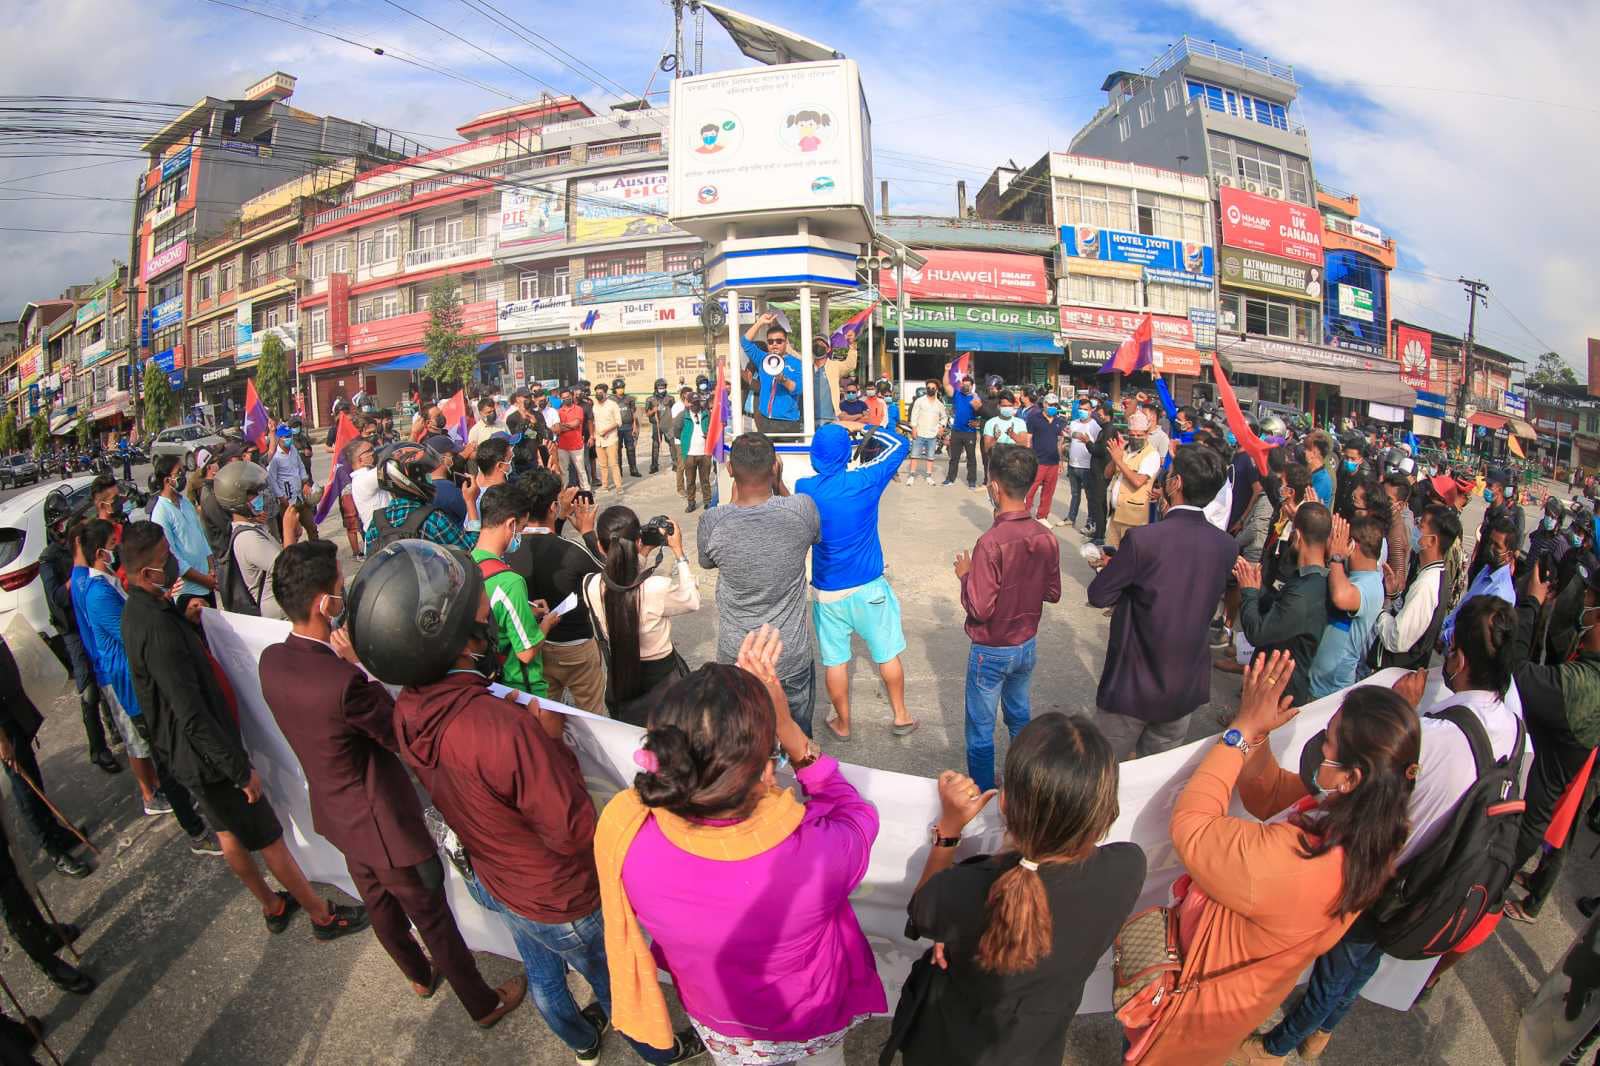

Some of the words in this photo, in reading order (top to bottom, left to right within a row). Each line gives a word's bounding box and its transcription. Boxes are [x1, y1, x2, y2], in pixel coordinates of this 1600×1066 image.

[1291, 214, 1307, 230] UK
[1112, 234, 1144, 247] HOTEL
[1279, 224, 1322, 246] CANADA
[927, 268, 993, 283] HUAWEI
